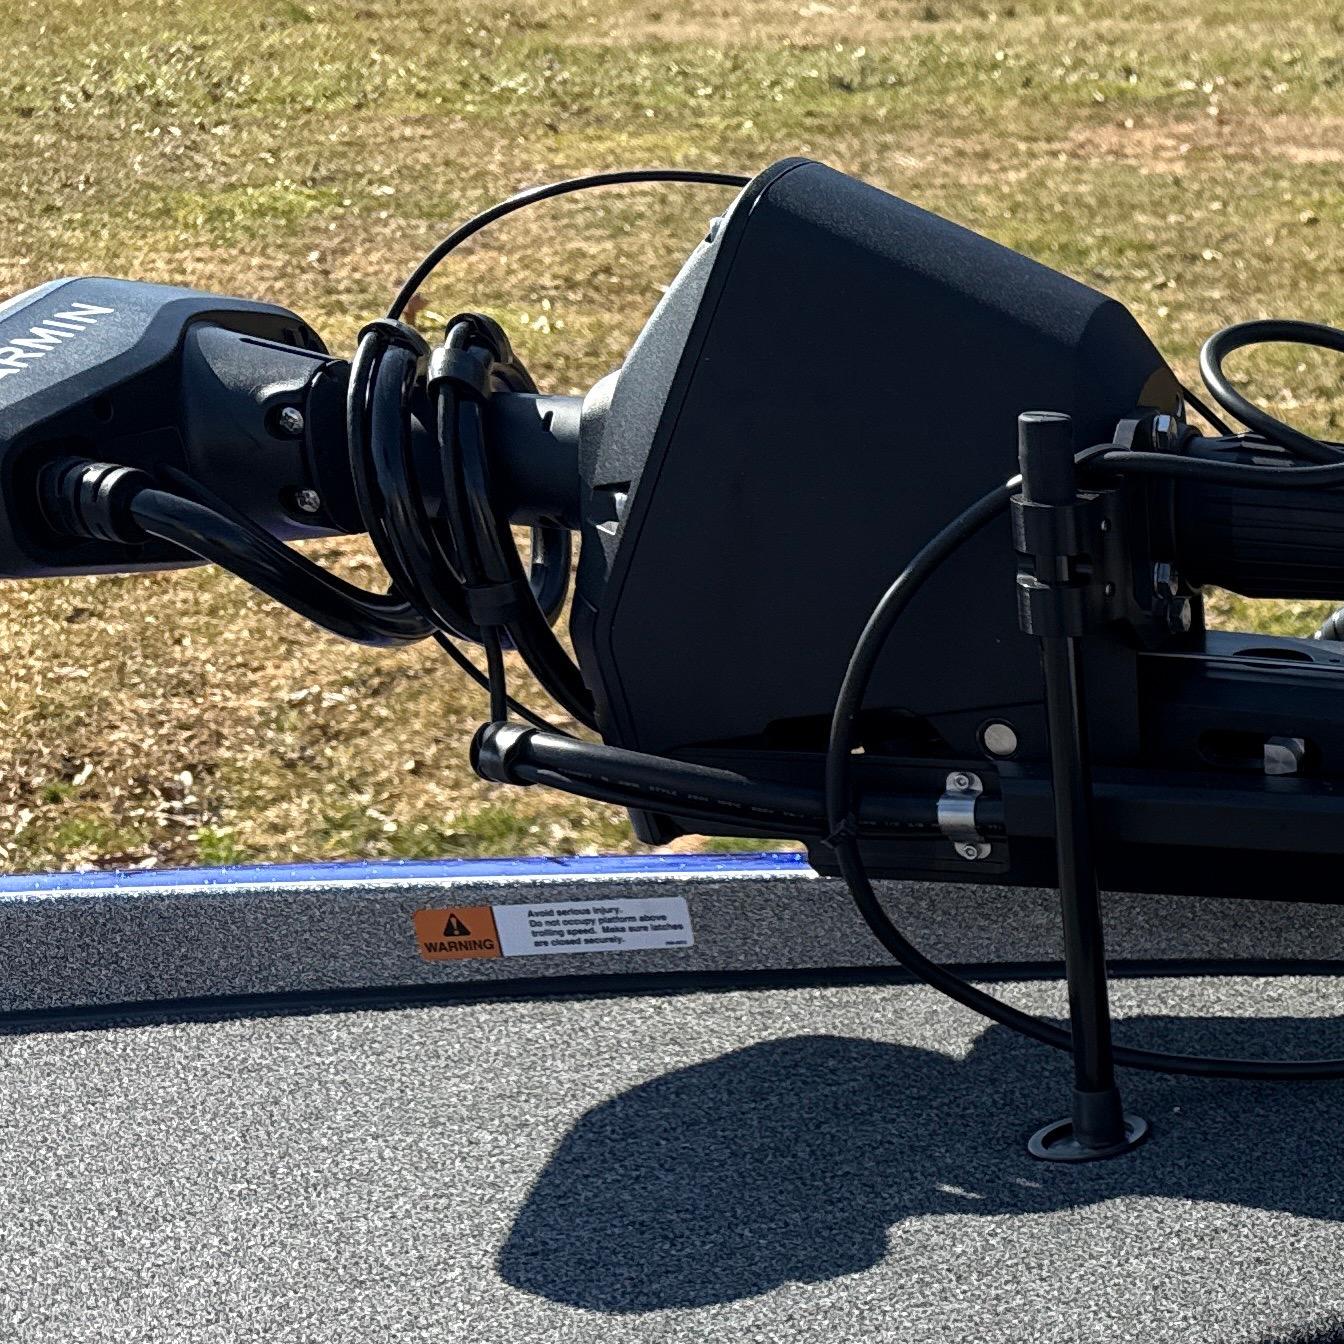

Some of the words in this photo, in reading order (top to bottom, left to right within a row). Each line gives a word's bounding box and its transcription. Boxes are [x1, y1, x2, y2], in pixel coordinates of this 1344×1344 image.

[528, 909, 554, 918] Avoid
[556, 907, 591, 916] serious
[529, 919, 543, 927] Do
[545, 919, 560, 927] not
[562, 918, 596, 927] occupy
[598, 915, 637, 925] platform
[639, 914, 667, 922] above
[531, 929, 565, 938] trolling
[650, 923, 683, 931] latches
[424, 938, 495, 953] WARNING
[550, 938, 582, 946] closed
